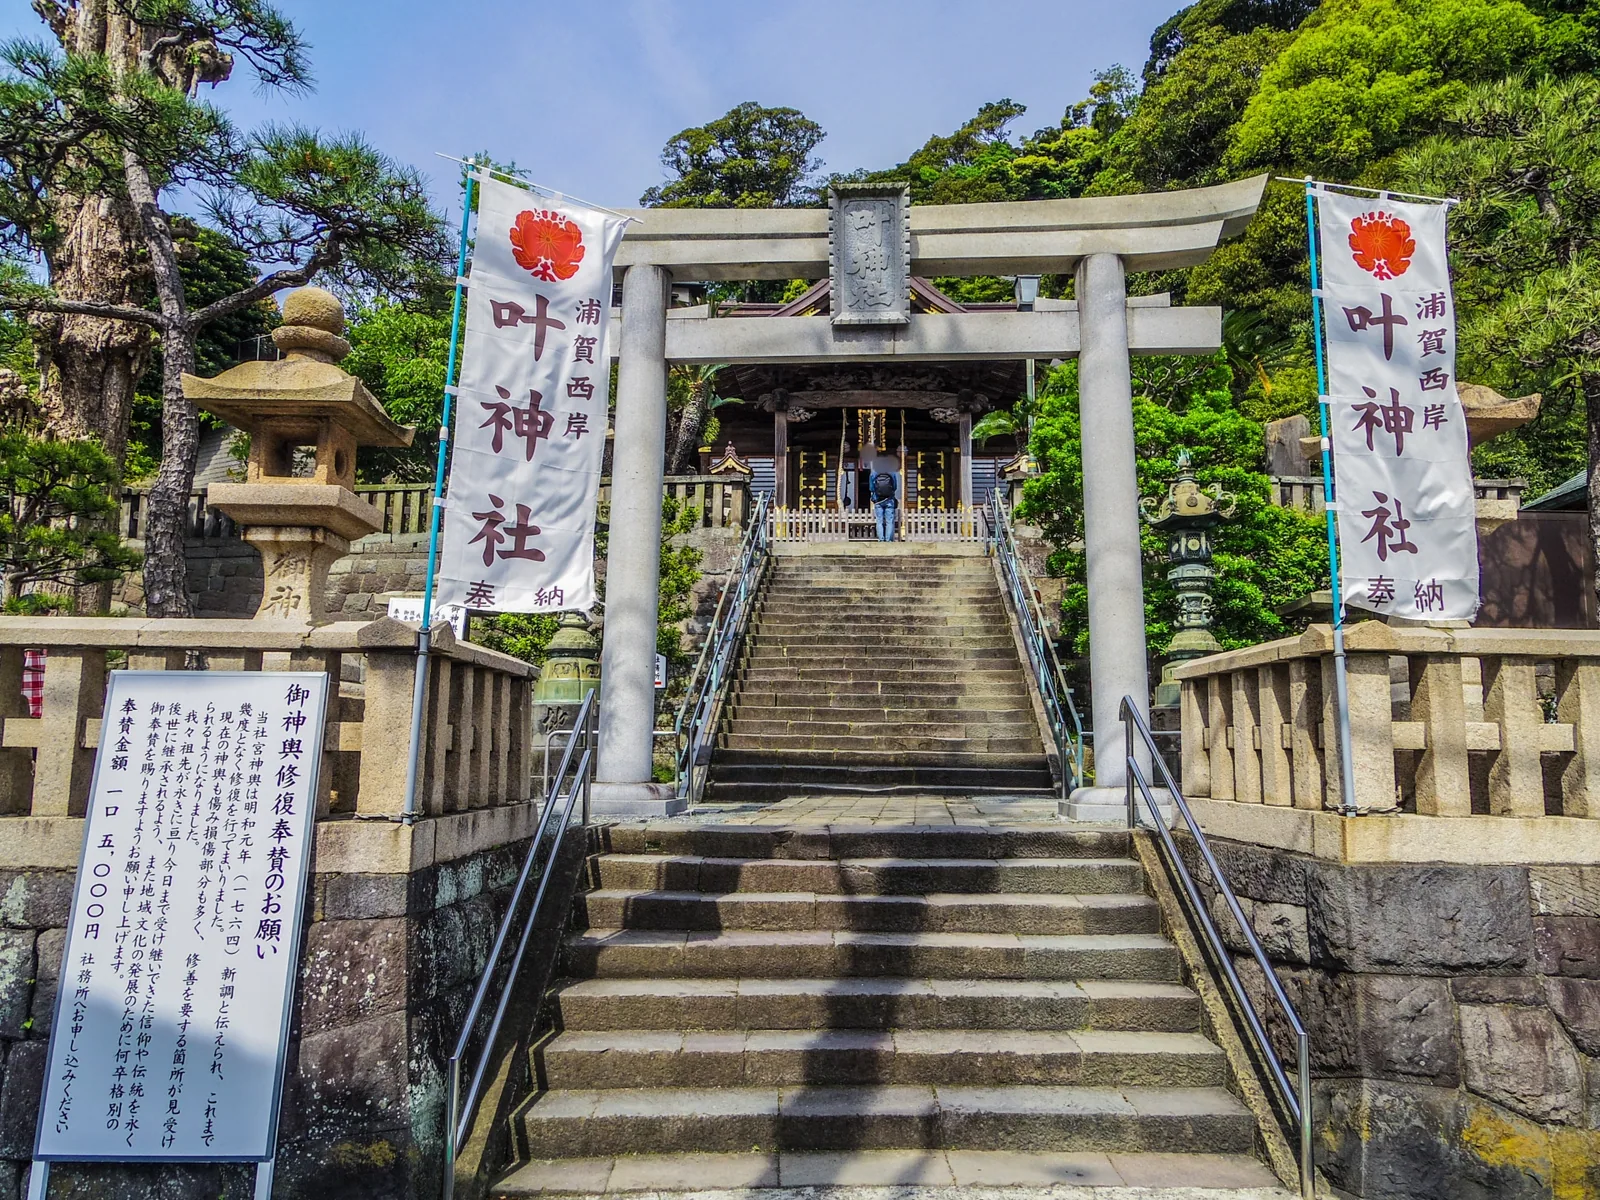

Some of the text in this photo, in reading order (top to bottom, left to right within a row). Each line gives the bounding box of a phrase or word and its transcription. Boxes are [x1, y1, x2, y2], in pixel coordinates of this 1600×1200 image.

[846, 203, 892, 310] 叶神社
[468, 293, 566, 567] 叶神社
[563, 298, 602, 439] 浦賀西岸
[1342, 293, 1419, 562] 叶神社
[1415, 292, 1450, 431] 浦賀西岸
[464, 580, 564, 608] 奉納
[1367, 575, 1445, 612] 奉納
[109, 697, 138, 772] 奉賛金額
[185, 701, 215, 846] られるようになりました。
[253, 683, 311, 959] 御神輿修復奉賛のお願い
